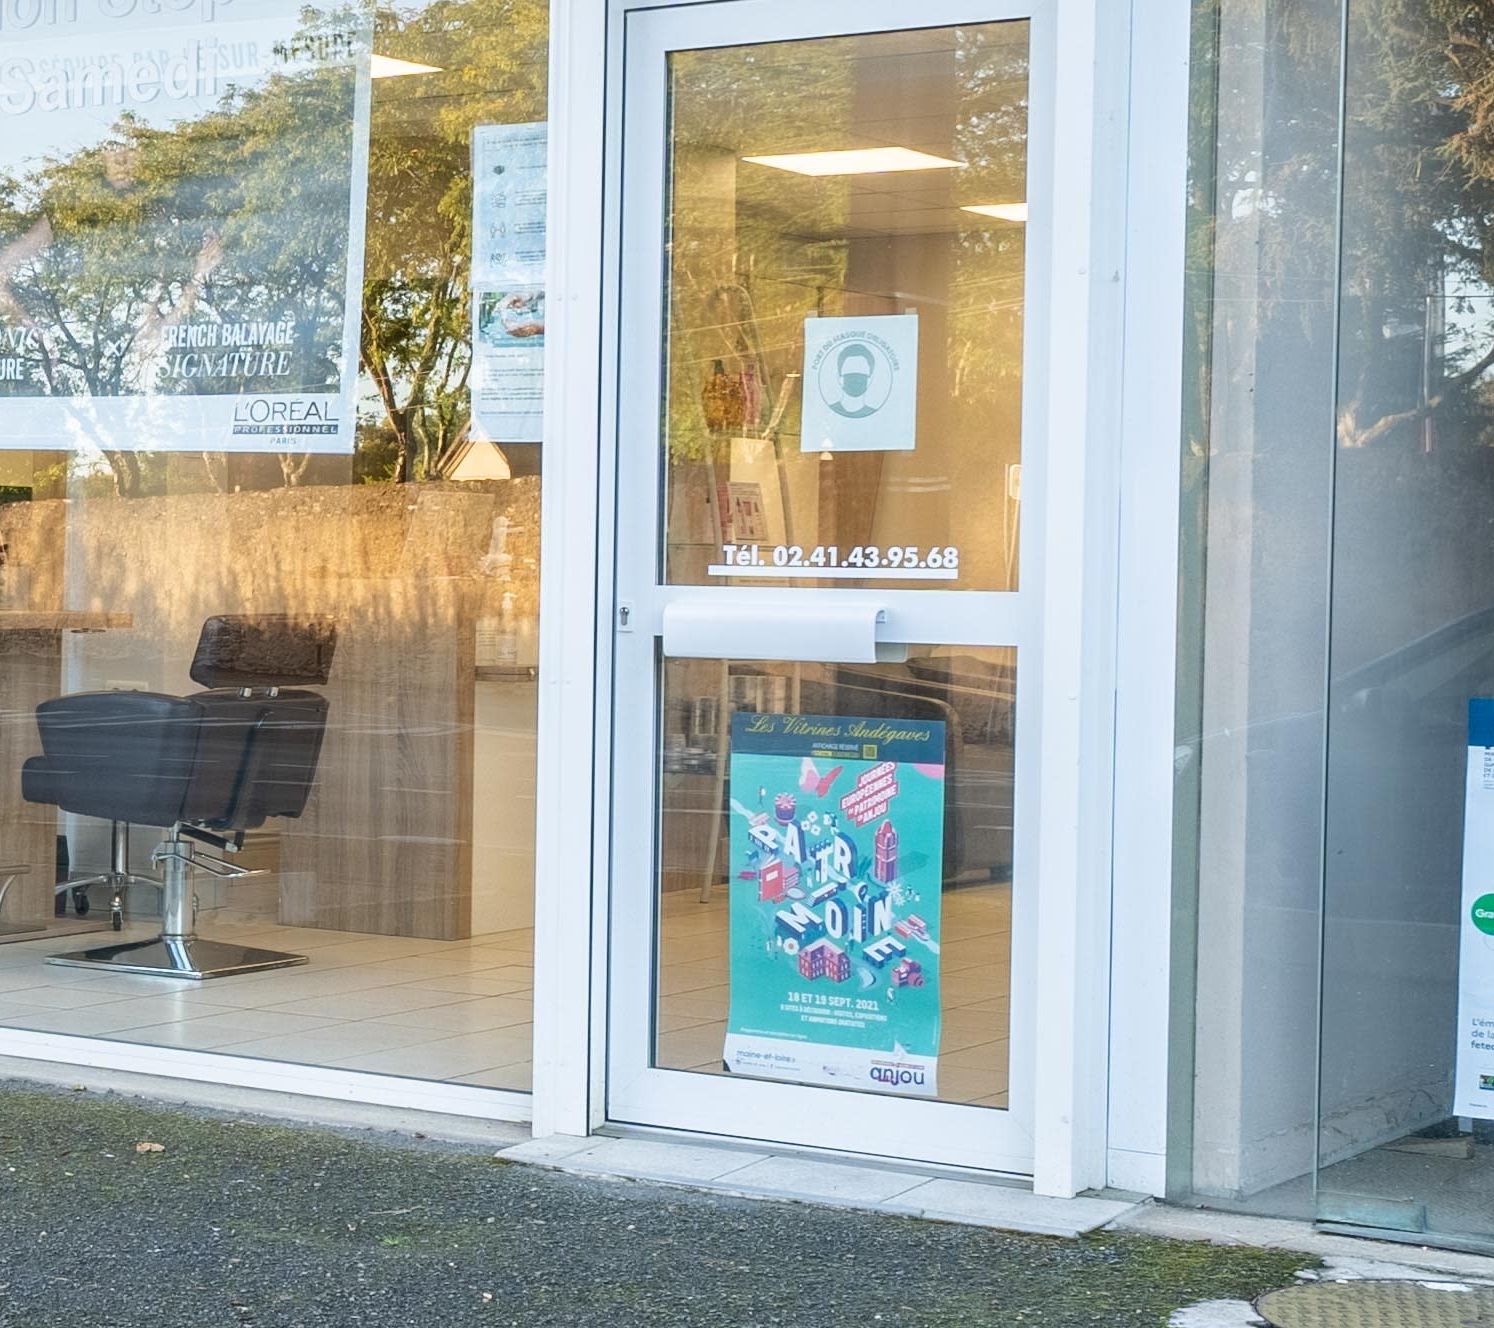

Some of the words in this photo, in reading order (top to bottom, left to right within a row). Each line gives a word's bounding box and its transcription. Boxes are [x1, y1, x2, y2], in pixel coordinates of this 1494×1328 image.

[0, 37, 219, 115] Samedi
[161, 324, 217, 348] FRENCH
[221, 320, 295, 346] BALAYAGE
[158, 349, 293, 379] SIGNATURE
[233, 399, 340, 423] L'ORÉAL
[233, 424, 339, 435] PROFESSIONNEL
[270, 437, 297, 445] PARIS
[723, 545, 765, 566] Tél.
[745, 714, 774, 733] Les
[781, 716, 841, 737] Vitrines
[844, 720, 930, 745] Andégaves
[801, 992, 813, 1003] ET
[828, 996, 854, 1008] SEPT.
[855, 999, 879, 1011] 2021
[1471, 1029, 1485, 1039] de
